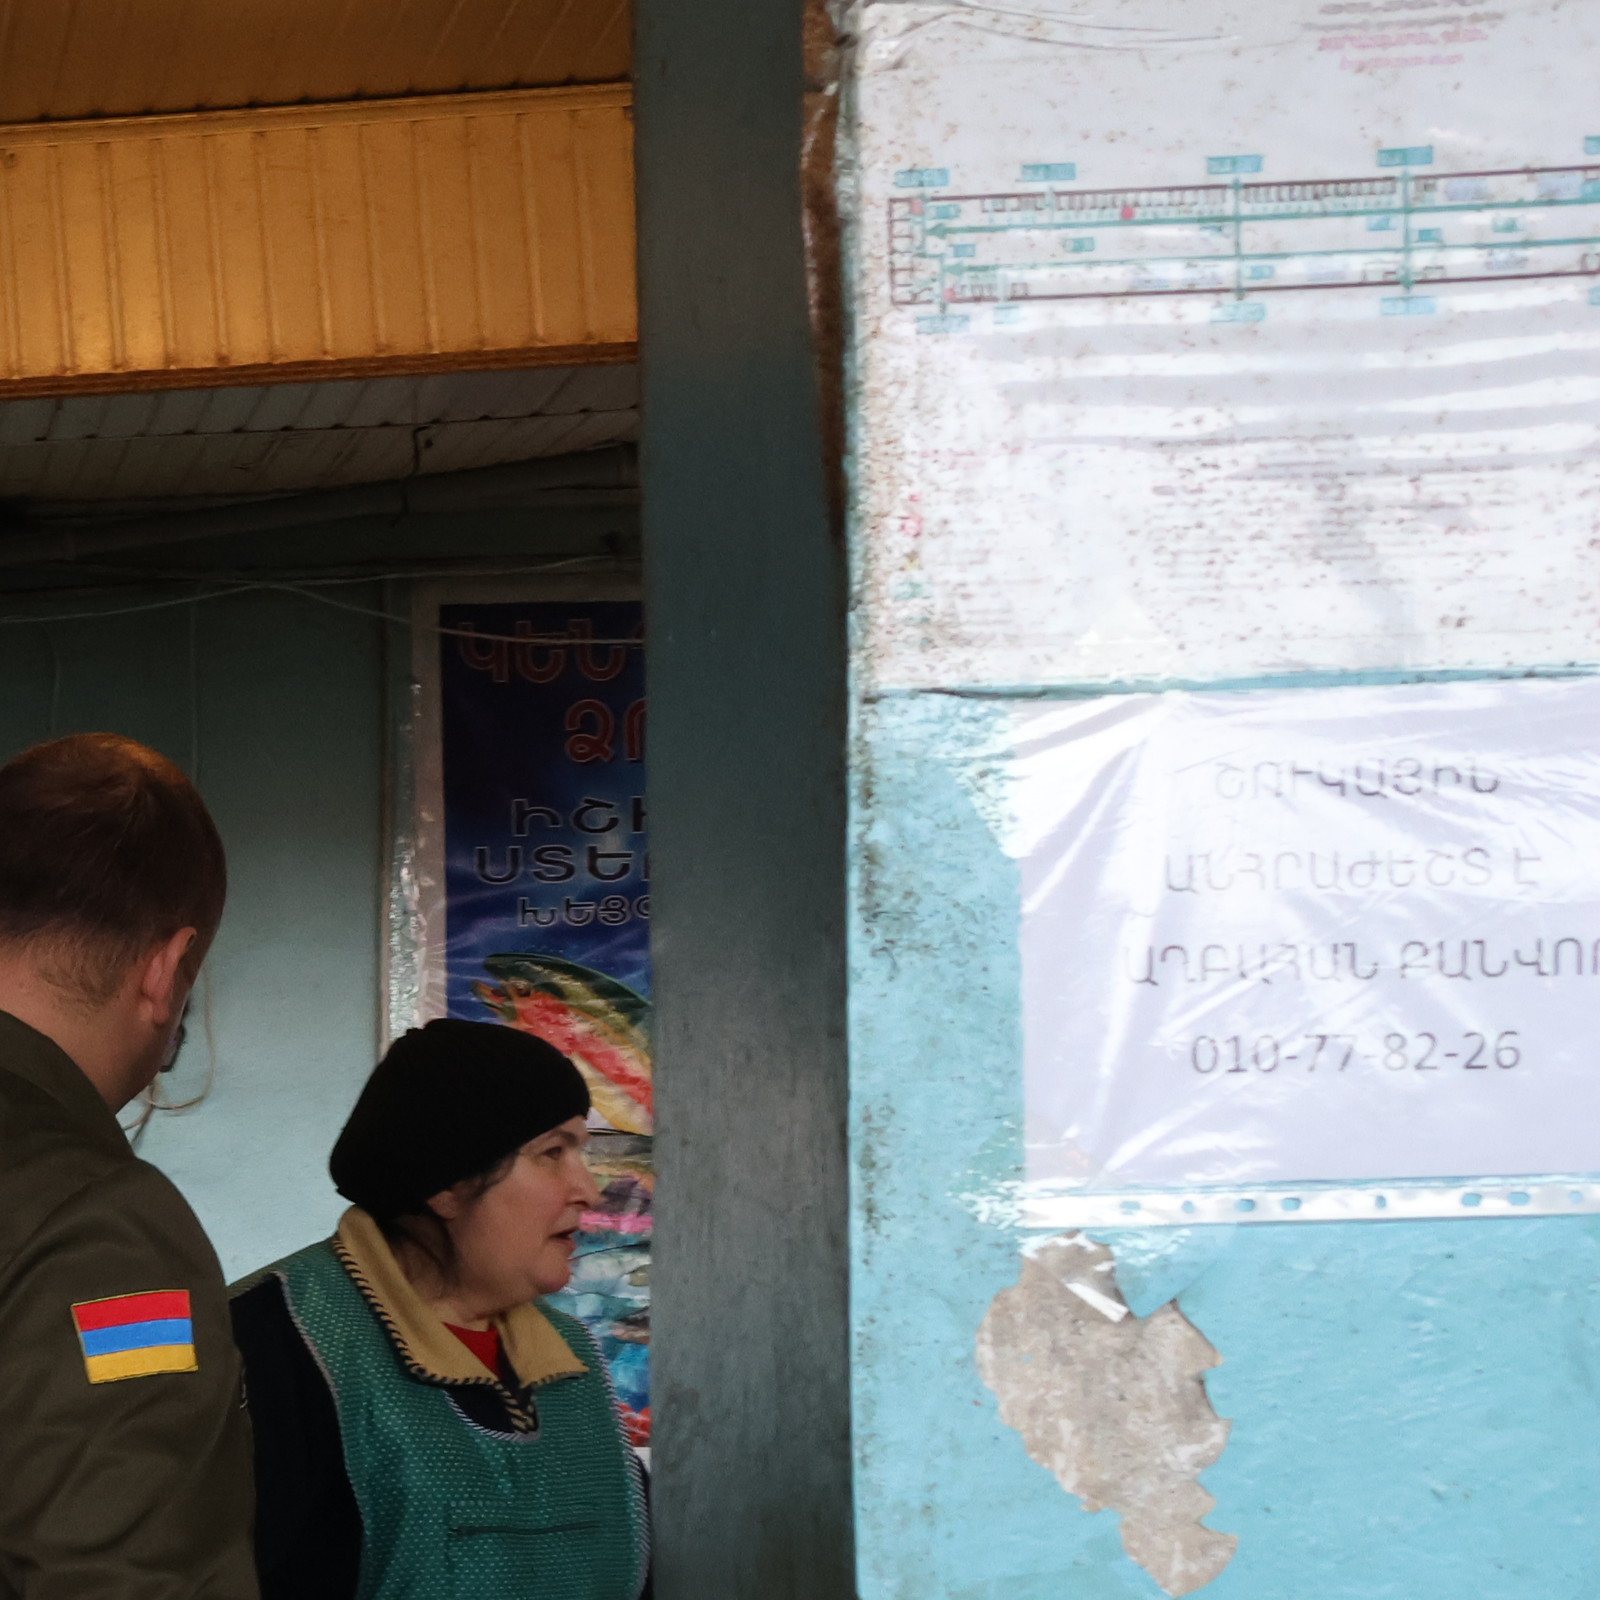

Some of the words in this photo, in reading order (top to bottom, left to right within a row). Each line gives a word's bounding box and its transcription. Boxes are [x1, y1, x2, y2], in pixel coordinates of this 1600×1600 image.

[1213, 756, 1501, 800] ՇՈՒԿԱՅԻՆ
[473, 843, 650, 885] ՍՏԵ
[1164, 846, 1493, 894] ԱՆՀՐԱԺԵՇՏ
[1512, 846, 1542, 888] Է
[1399, 936, 1600, 981] ԲԱՆՎՈ
[1189, 1030, 1522, 1075] 010-77-82-26
